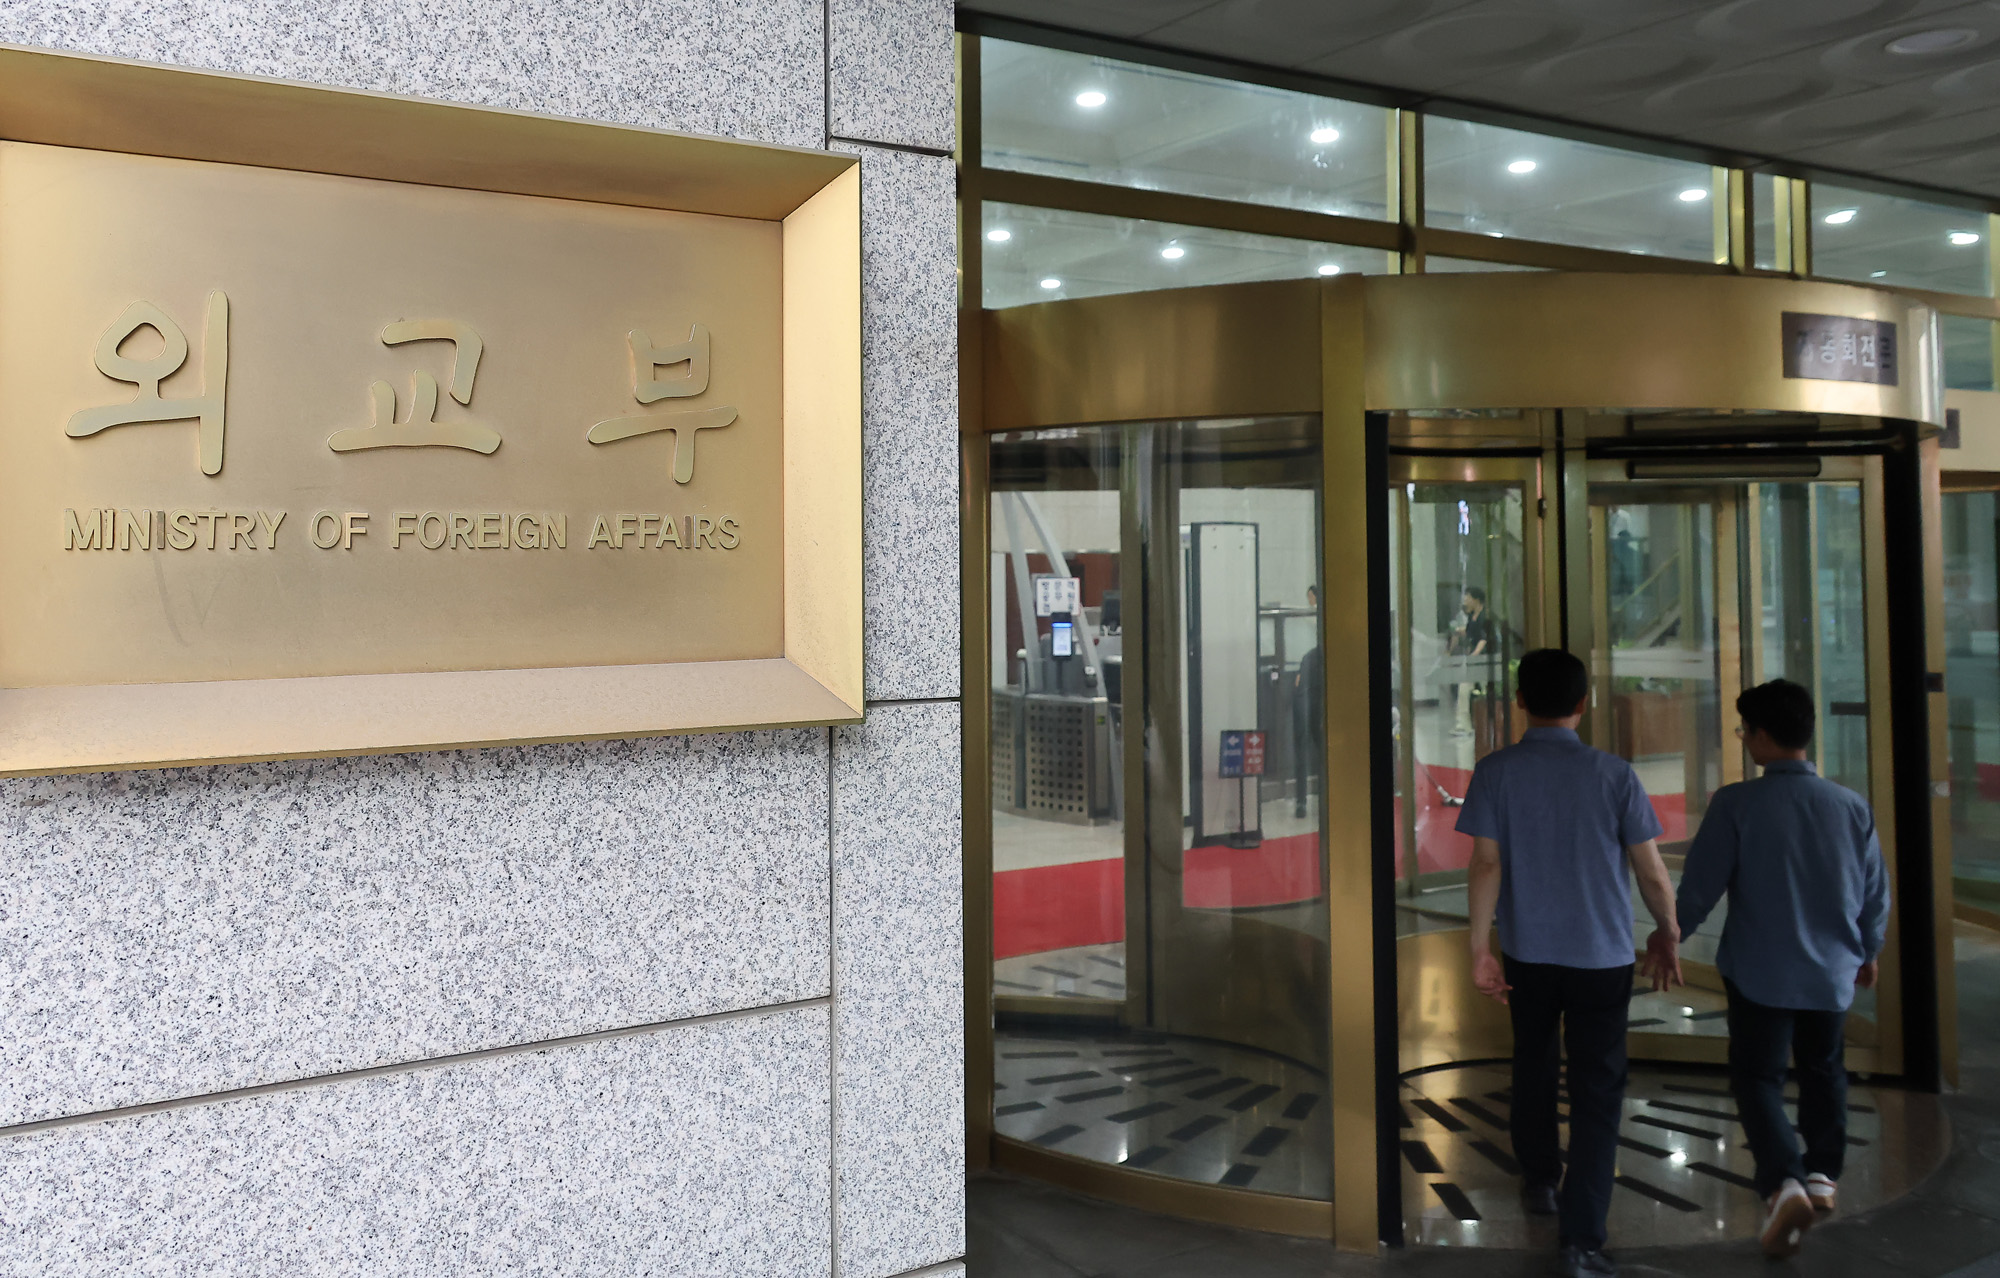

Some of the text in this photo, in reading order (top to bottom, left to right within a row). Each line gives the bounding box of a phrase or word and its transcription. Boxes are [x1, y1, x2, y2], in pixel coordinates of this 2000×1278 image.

[65, 289, 739, 484] 외교부
[63, 508, 741, 551] MINISTRY OF FOREIGN AFFAIRS
